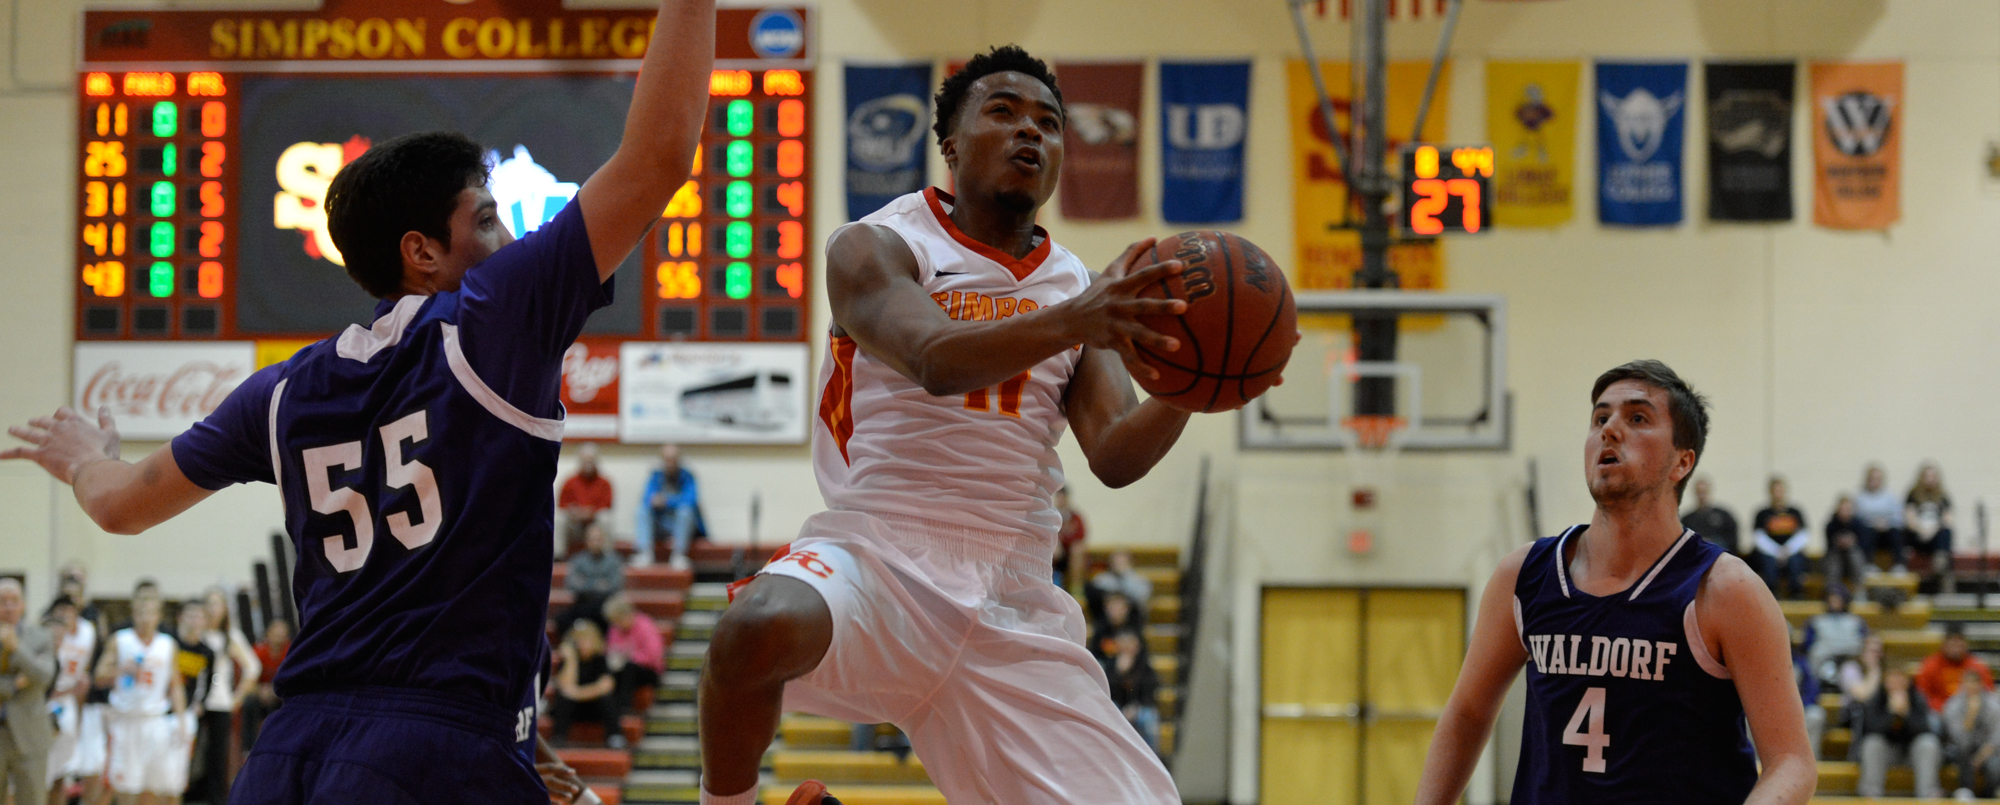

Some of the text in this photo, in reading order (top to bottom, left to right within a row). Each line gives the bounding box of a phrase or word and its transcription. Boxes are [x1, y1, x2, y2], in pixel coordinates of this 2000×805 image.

[209, 17, 657, 59] SIMPSON COLLEG
[96, 102, 128, 136] 11
[1411, 178, 1480, 235] 27
[83, 221, 126, 257] 41
[668, 221, 702, 258] 11
[302, 409, 443, 574] 55
[1528, 634, 1677, 681] WALDORF
[1562, 687, 1610, 773] 4
